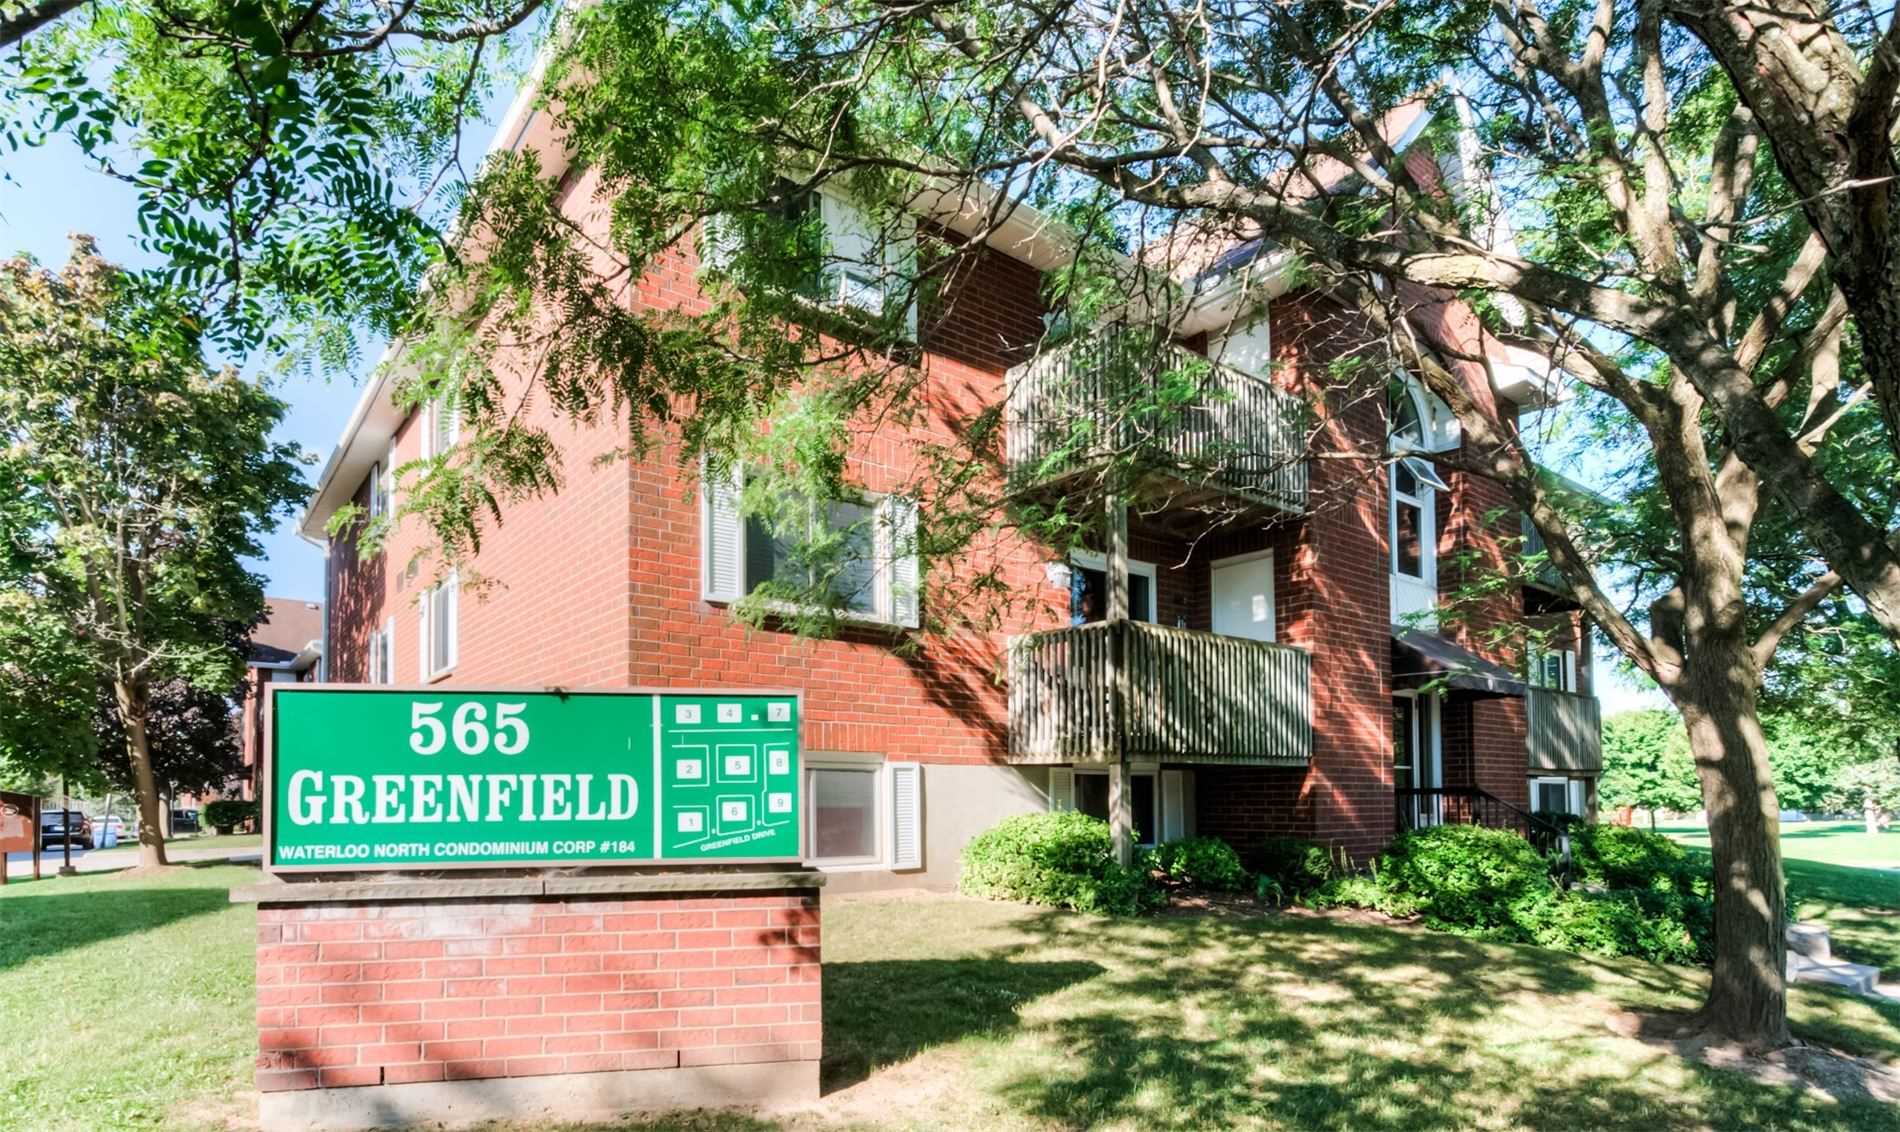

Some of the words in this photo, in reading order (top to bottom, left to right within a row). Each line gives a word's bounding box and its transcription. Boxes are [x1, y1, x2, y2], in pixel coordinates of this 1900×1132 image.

[685, 709, 693, 719] 3
[725, 708, 733, 718] 4
[775, 707, 783, 718] 7
[408, 700, 531, 756] 565
[734, 760, 742, 771] 5
[775, 758, 783, 769] 8
[685, 764, 694, 775] 2
[286, 768, 640, 826] GREENFIELD
[776, 798, 785, 809] 9
[731, 807, 739, 818] 6
[700, 834, 751, 852] GREENFIELD
[751, 828, 776, 840] DRIVE
[278, 843, 371, 860] WATERLOO
[373, 842, 431, 858] NORTH
[433, 840, 549, 857] CONDOMINIUM
[552, 840, 597, 856] CORP
[599, 840, 636, 854] #184
